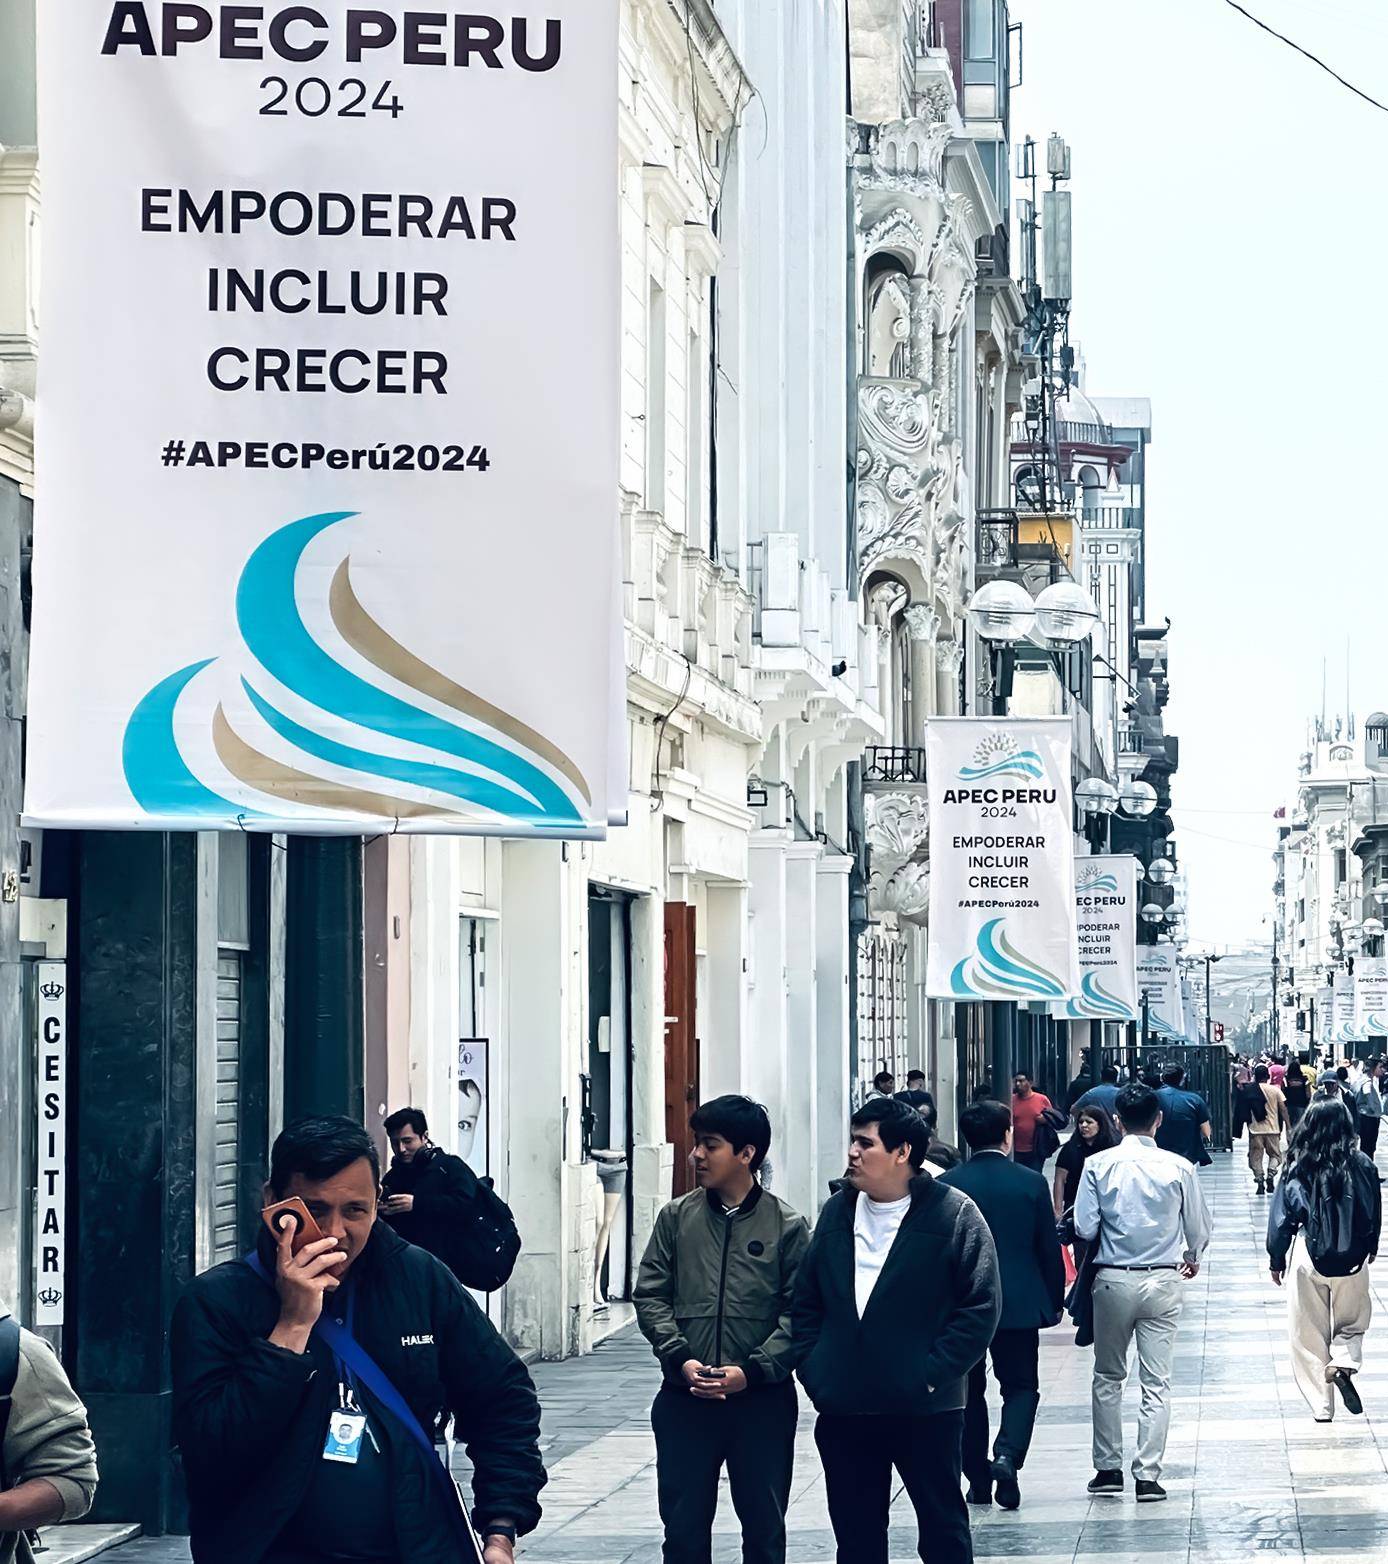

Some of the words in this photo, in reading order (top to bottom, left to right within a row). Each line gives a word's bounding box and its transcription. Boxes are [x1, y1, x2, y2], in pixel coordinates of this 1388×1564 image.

[101, 1, 330, 63] APEC
[346, 11, 563, 73] PERU
[258, 77, 404, 119] 2024
[141, 188, 517, 241] EMPODERAR
[208, 267, 449, 317] INCLUIR
[207, 346, 448, 394] CRECER
[161, 440, 490, 472] #APECPerú2024
[943, 789, 998, 804] APEC
[1002, 789, 1056, 804] PERU
[981, 807, 1017, 818] 2024
[952, 836, 1045, 849] EMPODERAR
[968, 856, 1029, 868] INCLUIR
[968, 876, 1029, 889] CRECER
[958, 900, 1040, 909] #APECPerú2024
[1076, 897, 1092, 905] EC
[1094, 896, 1126, 905] PERU
[1078, 935, 1111, 943] NCLUIR
[42, 1016, 61, 1274] CESITAR
